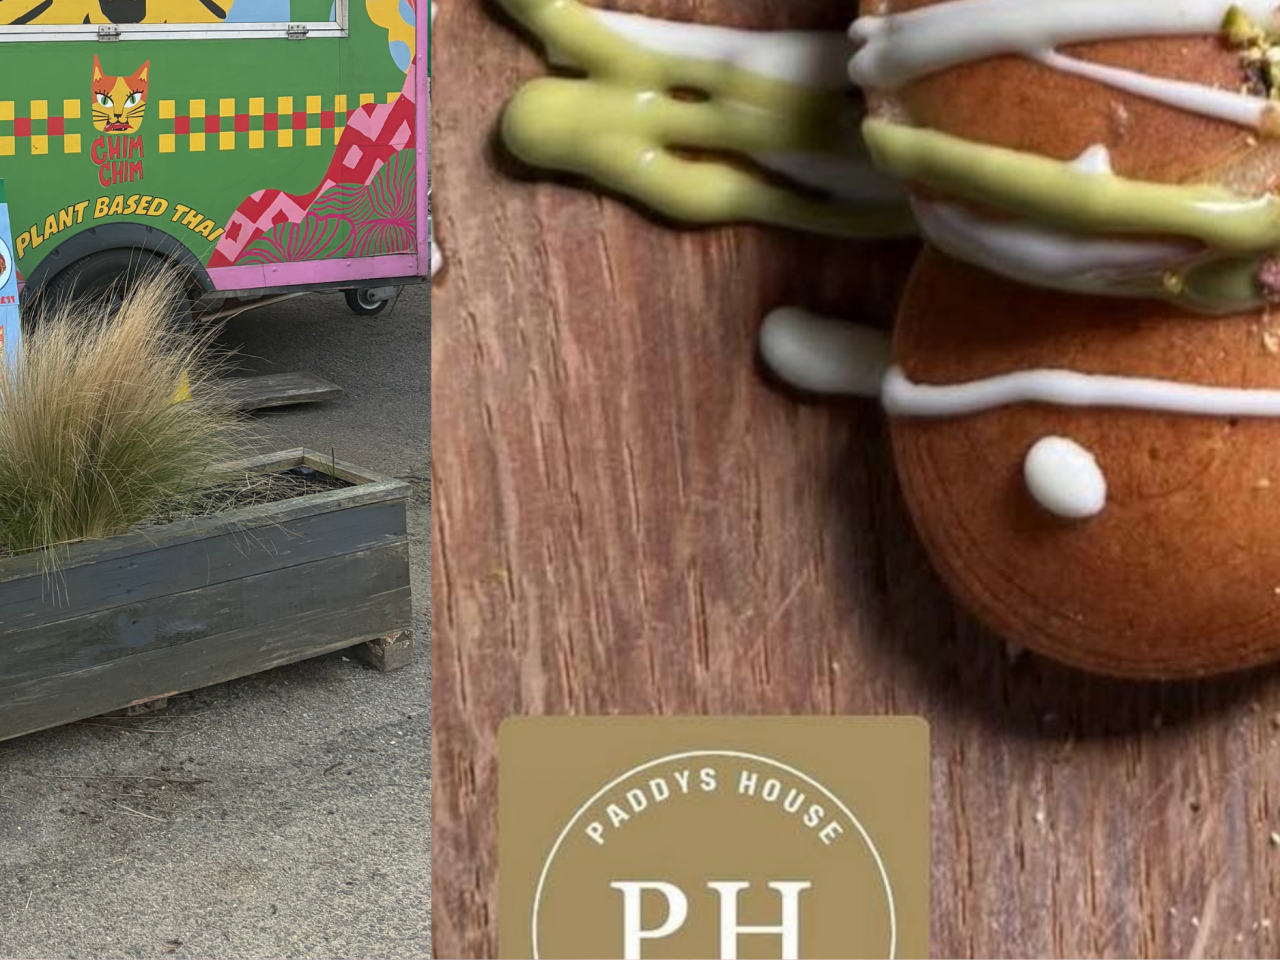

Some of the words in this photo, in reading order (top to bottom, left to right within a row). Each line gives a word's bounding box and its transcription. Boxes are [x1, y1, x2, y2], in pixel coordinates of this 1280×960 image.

[91, 135, 144, 166] CHIM
[98, 161, 144, 187] CHIM
[15, 199, 90, 260] PLANT
[93, 194, 169, 220] BASED
[171, 203, 226, 242] THAI
[0, 295, 17, 305] £11
